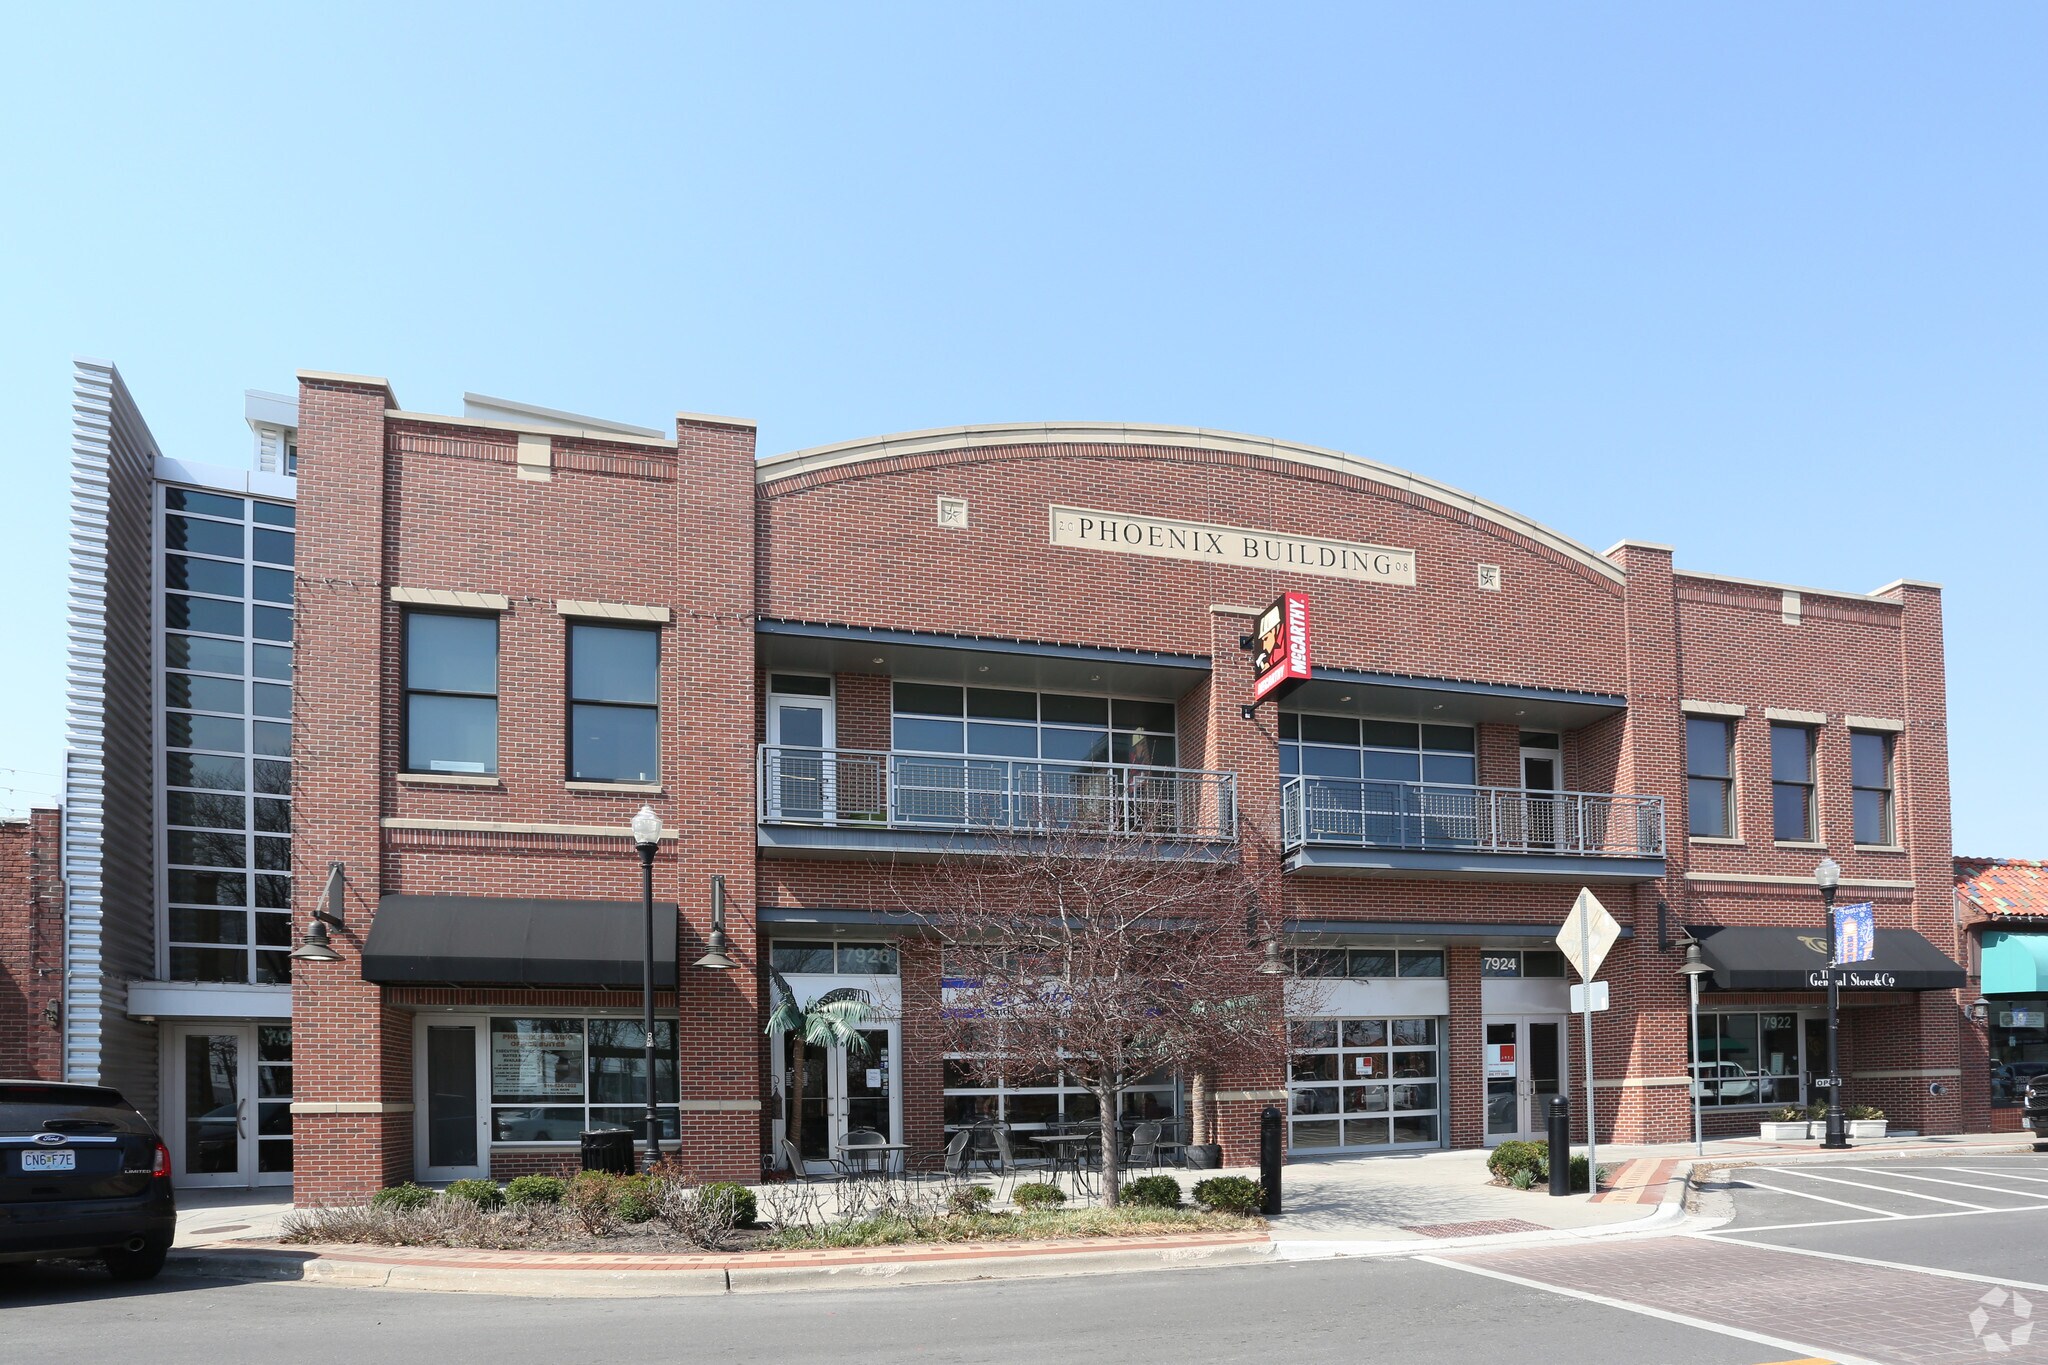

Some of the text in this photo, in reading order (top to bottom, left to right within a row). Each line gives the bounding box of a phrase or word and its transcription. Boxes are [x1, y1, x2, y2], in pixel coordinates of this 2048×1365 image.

[1058, 517, 1408, 574] 20 PHOENIX BUILDING 08
[843, 947, 890, 963] 7926
[1484, 957, 1517, 970] 7924
[1809, 972, 1847, 987] Genal
[1763, 1016, 1791, 1029] 7922
